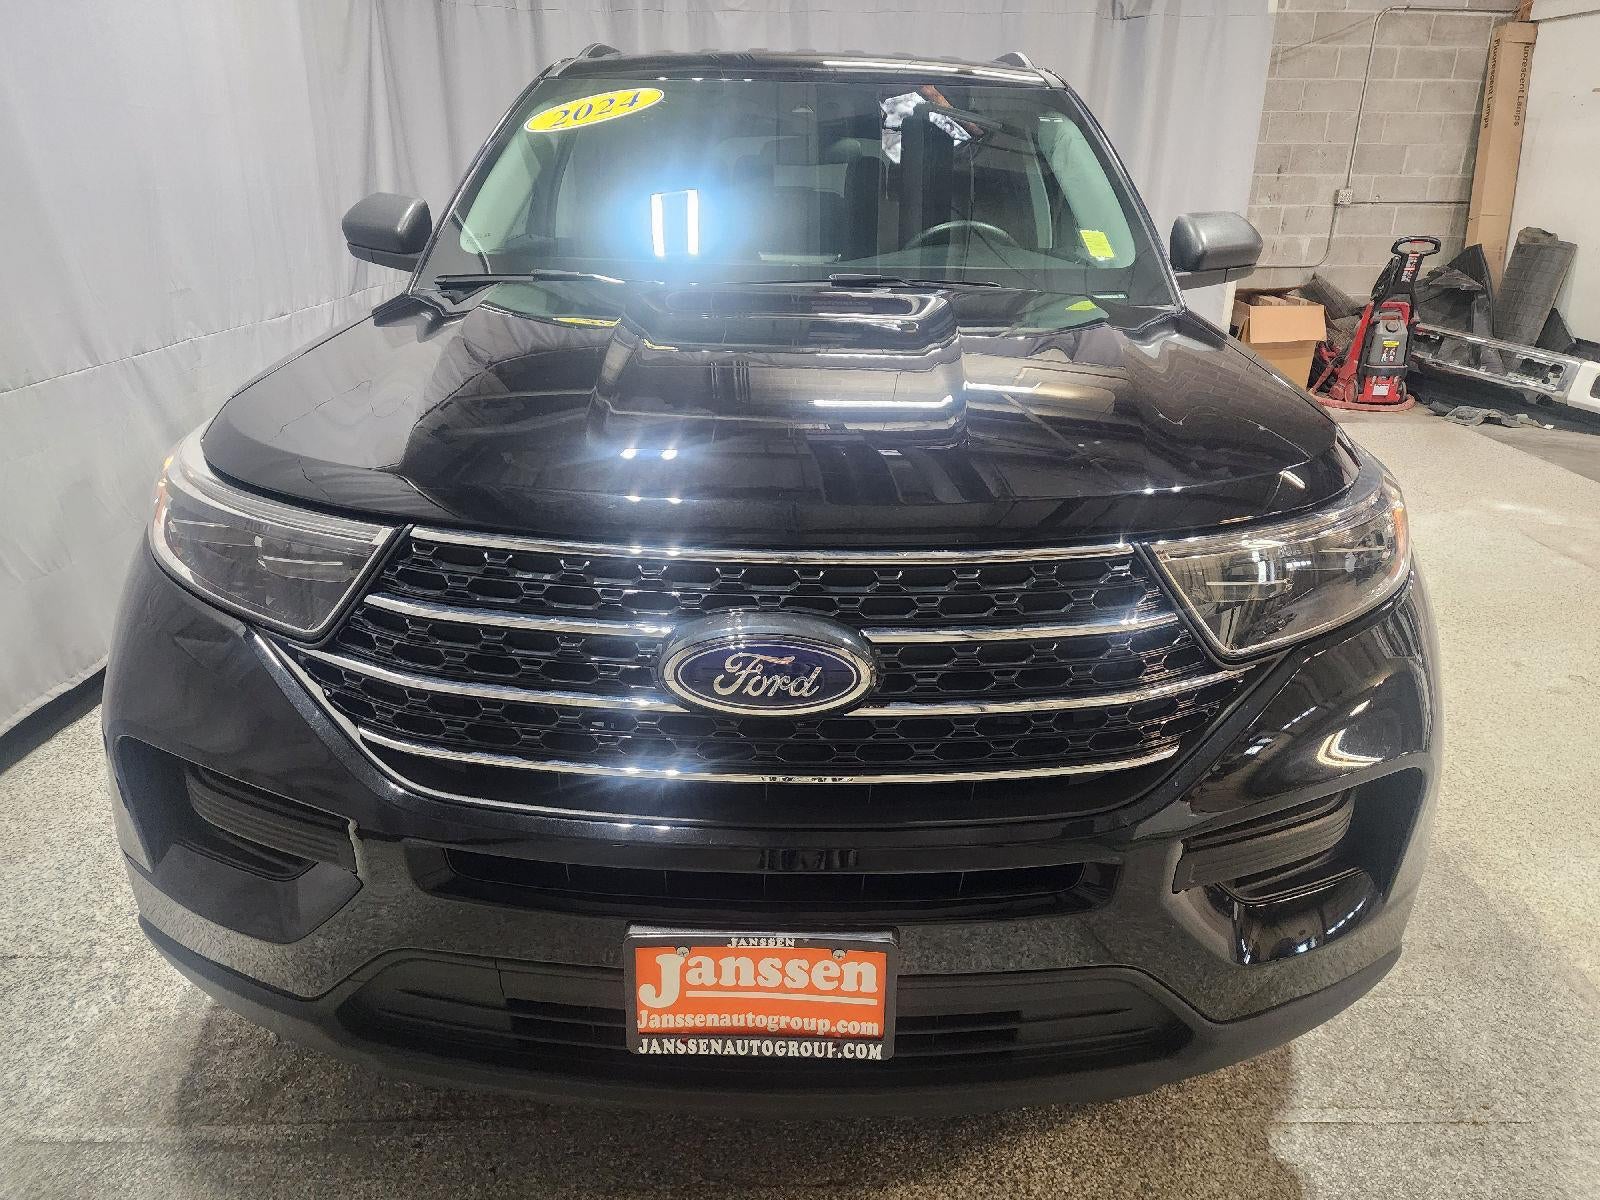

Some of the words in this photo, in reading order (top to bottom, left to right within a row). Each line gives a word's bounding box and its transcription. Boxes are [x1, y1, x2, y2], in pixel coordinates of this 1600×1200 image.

[1487, 38, 1500, 95] Fluorescent
[1519, 42, 1530, 95] luorescent
[549, 91, 641, 127] 2024
[1484, 96, 1494, 128] Lamps
[1513, 95, 1525, 127] Lamps
[713, 652, 823, 698] Ford
[726, 937, 796, 949] JANSSEN
[638, 953, 878, 1008] Janssen
[637, 1009, 879, 1035] Janssenautogroup.com
